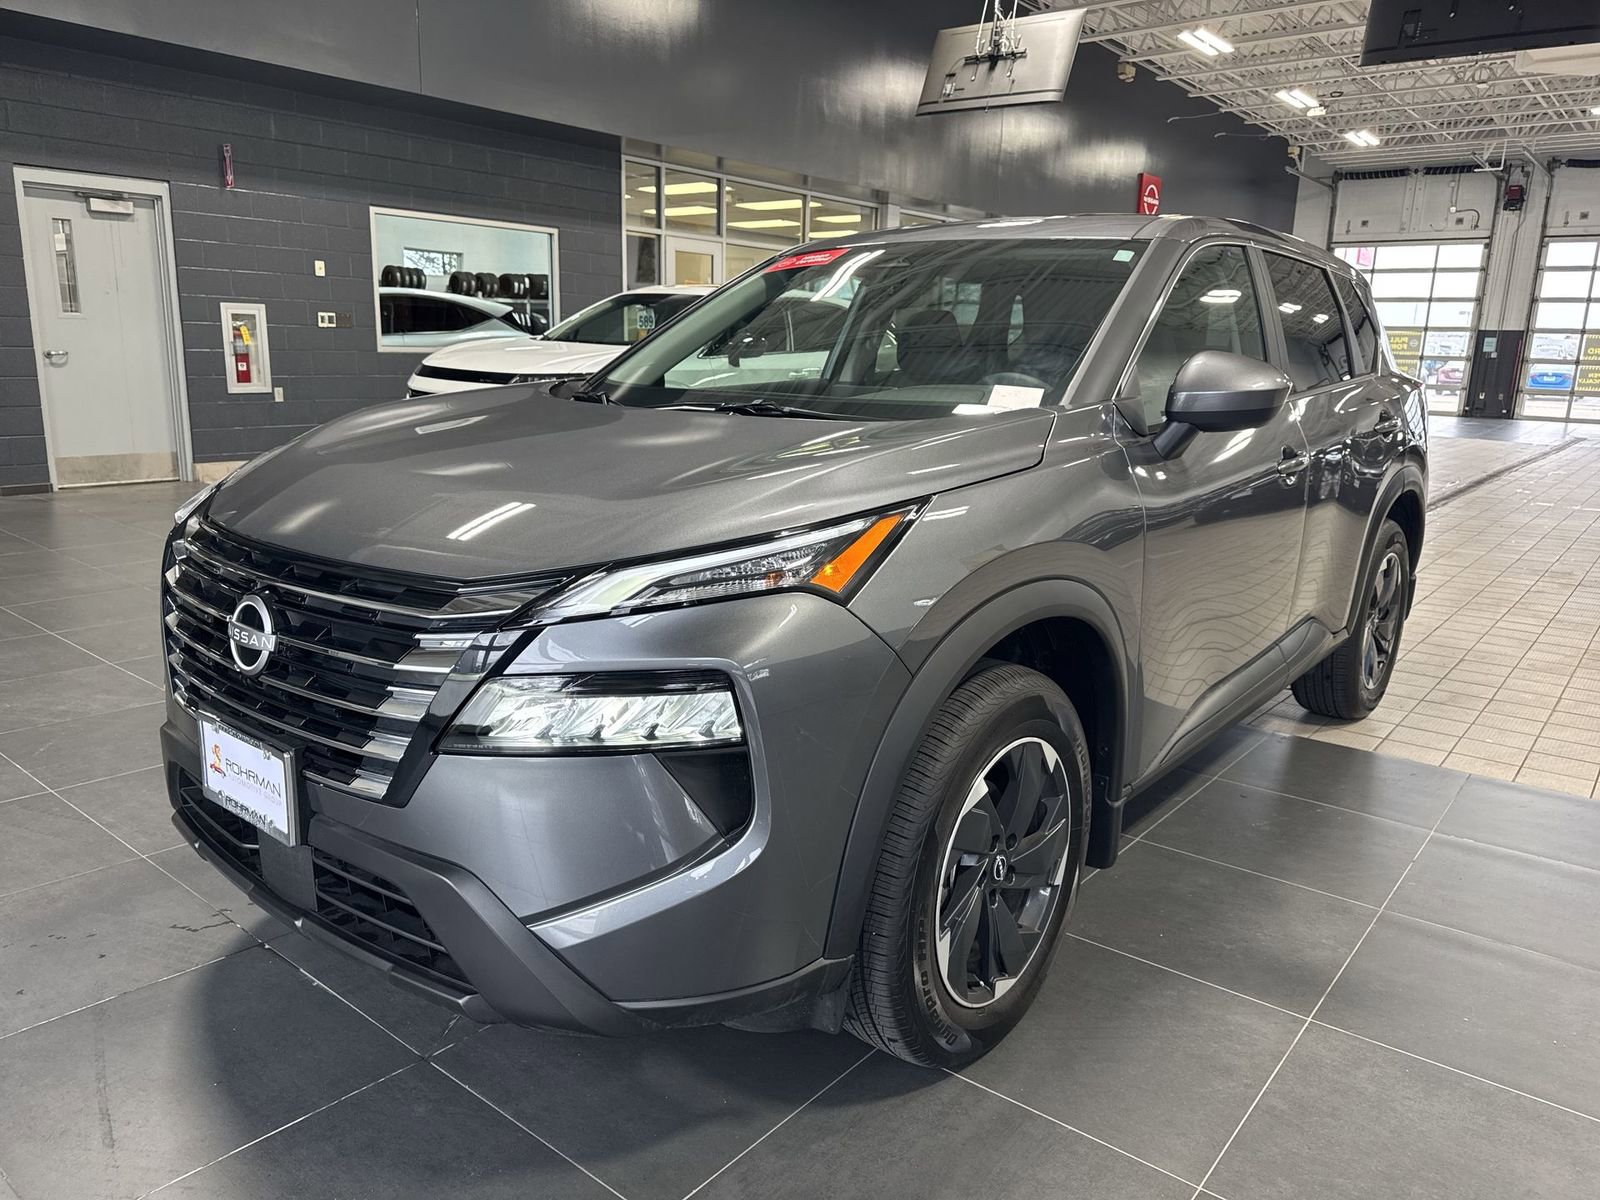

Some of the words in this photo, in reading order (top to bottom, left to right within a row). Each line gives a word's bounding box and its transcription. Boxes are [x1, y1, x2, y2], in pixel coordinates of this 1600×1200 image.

[1143, 196, 1159, 205] NISSAN
[639, 315, 653, 328] 589
[225, 758, 282, 798] ROHRMAN
[225, 796, 266, 826] ROHRMAN
